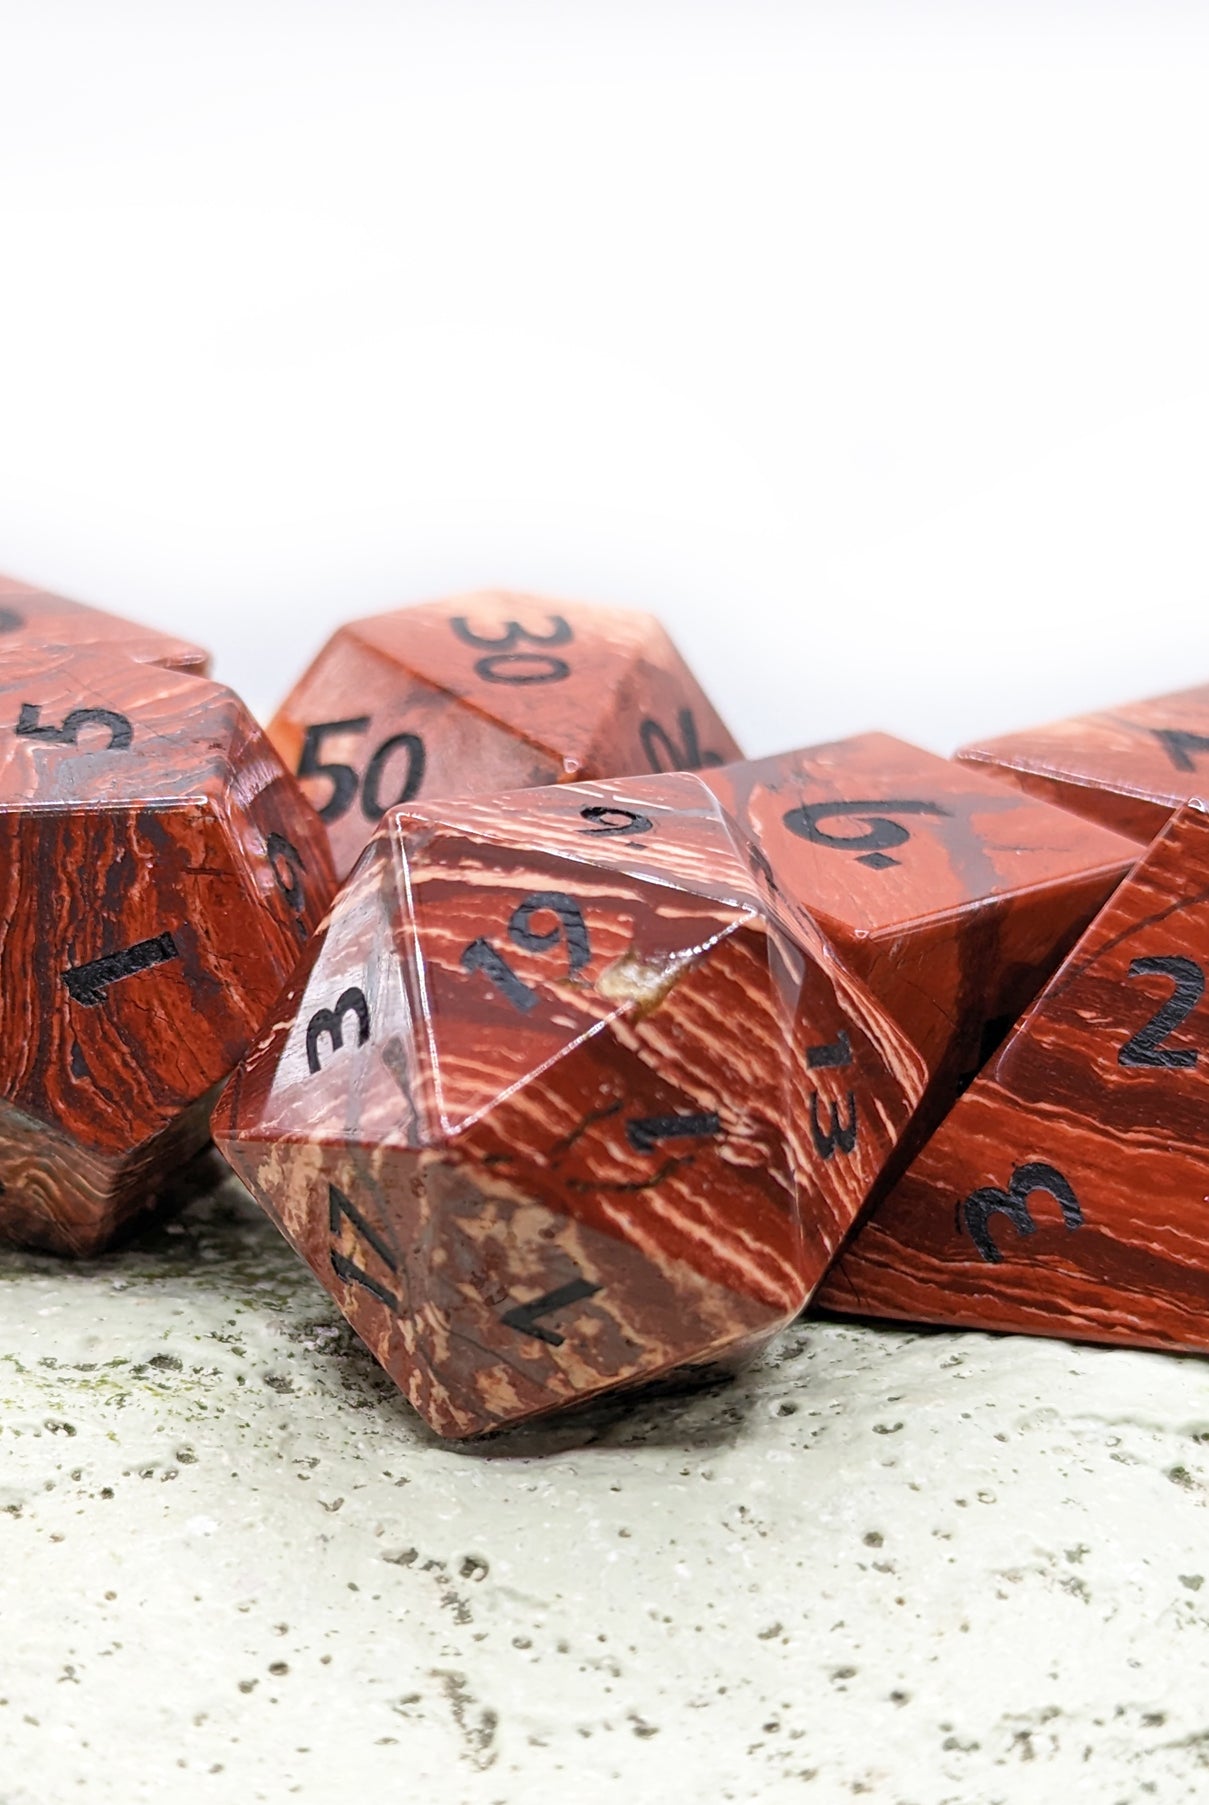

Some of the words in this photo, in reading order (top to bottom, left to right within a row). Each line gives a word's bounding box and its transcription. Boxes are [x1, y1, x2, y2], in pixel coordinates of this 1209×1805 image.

[450, 615, 573, 686] 30
[15, 703, 134, 750] 5
[298, 717, 426, 823] 50
[62, 932, 179, 1006] 1
[460, 891, 592, 1013] 19
[306, 986, 371, 1075] 3
[1118, 955, 1205, 1069] 2
[626, 1111, 721, 1155] 1
[964, 1162, 1085, 1263] 3
[501, 1278, 604, 1348] 7
